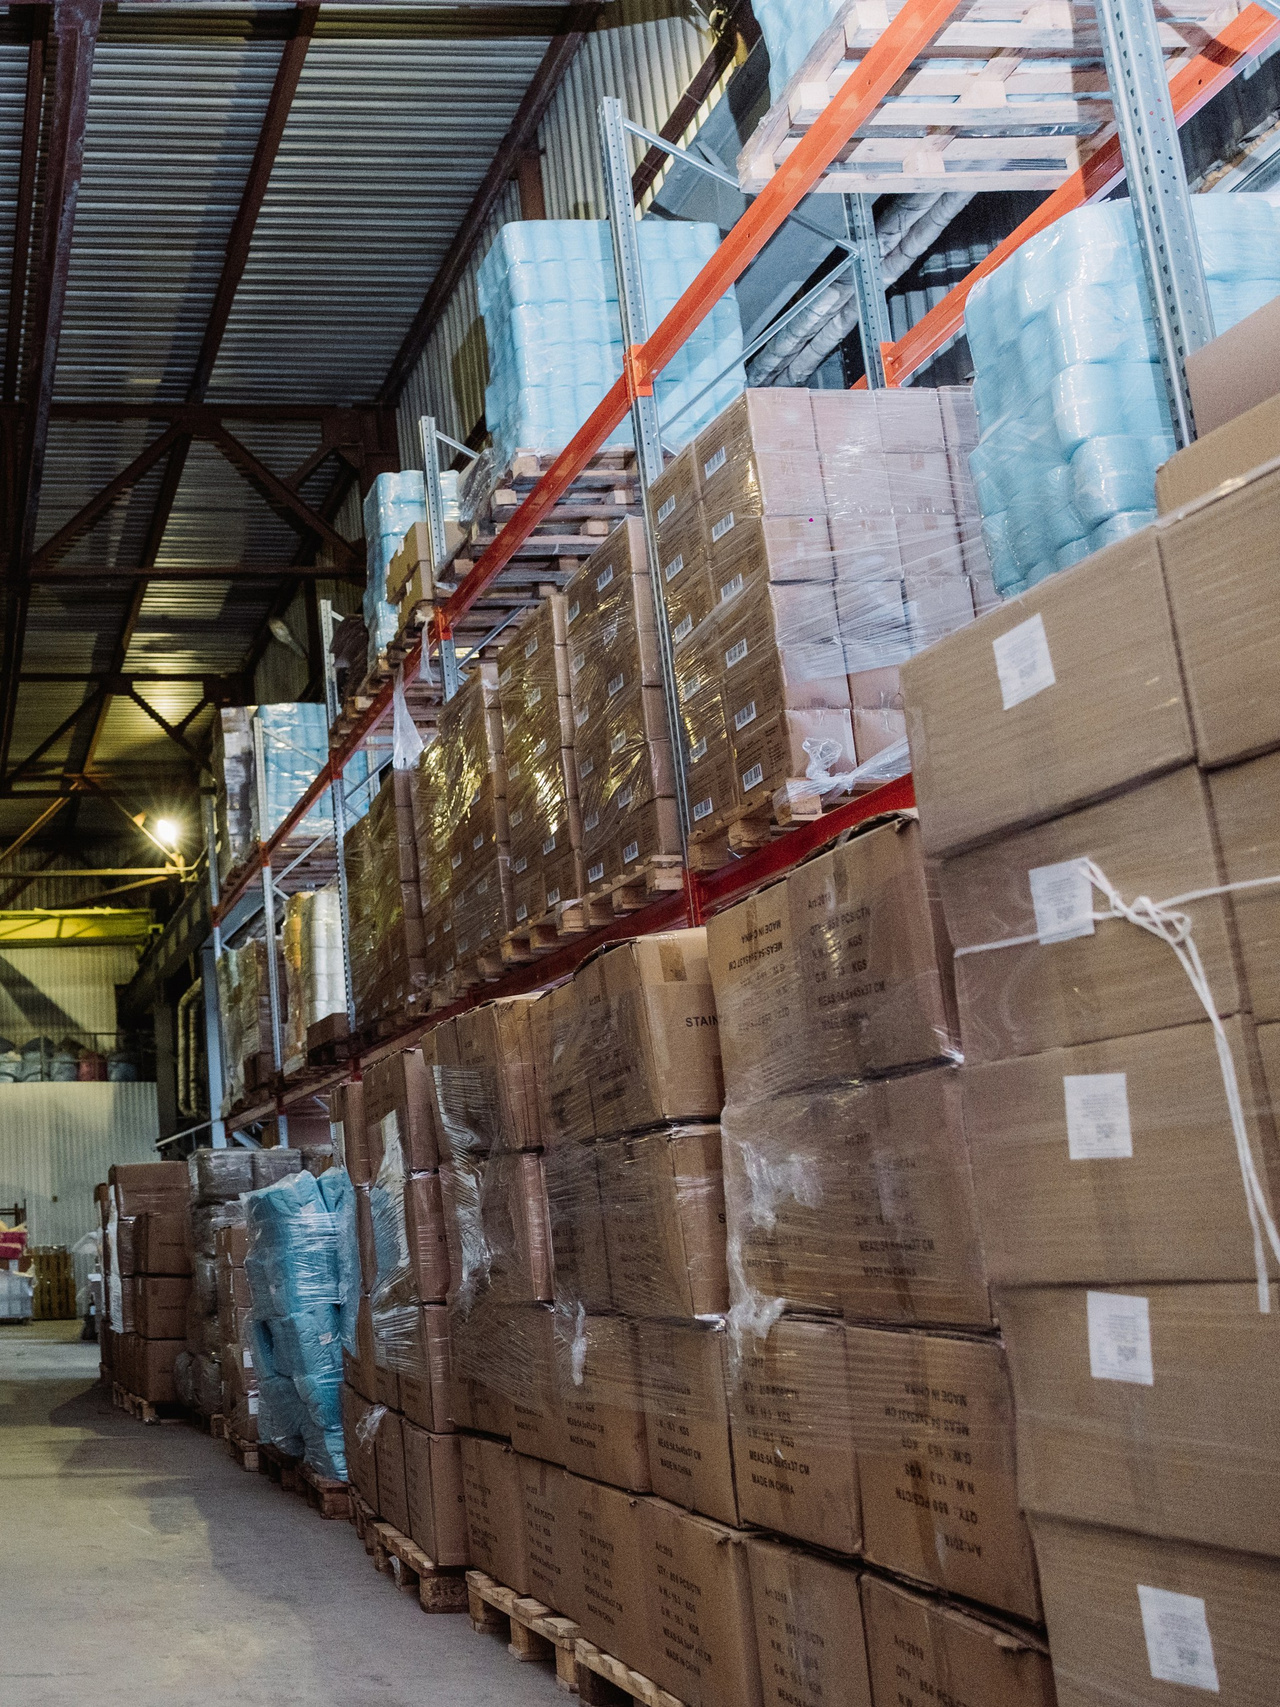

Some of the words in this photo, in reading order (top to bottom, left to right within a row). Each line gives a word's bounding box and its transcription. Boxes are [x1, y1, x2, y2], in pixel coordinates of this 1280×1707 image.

[765, 919, 780, 933] MADE
[852, 957, 867, 974] KGS
[799, 1463, 809, 1475] CM
[751, 1473, 767, 1487] MADE
[768, 1478, 774, 1489] IN
[775, 1480, 794, 1494] CHINA
